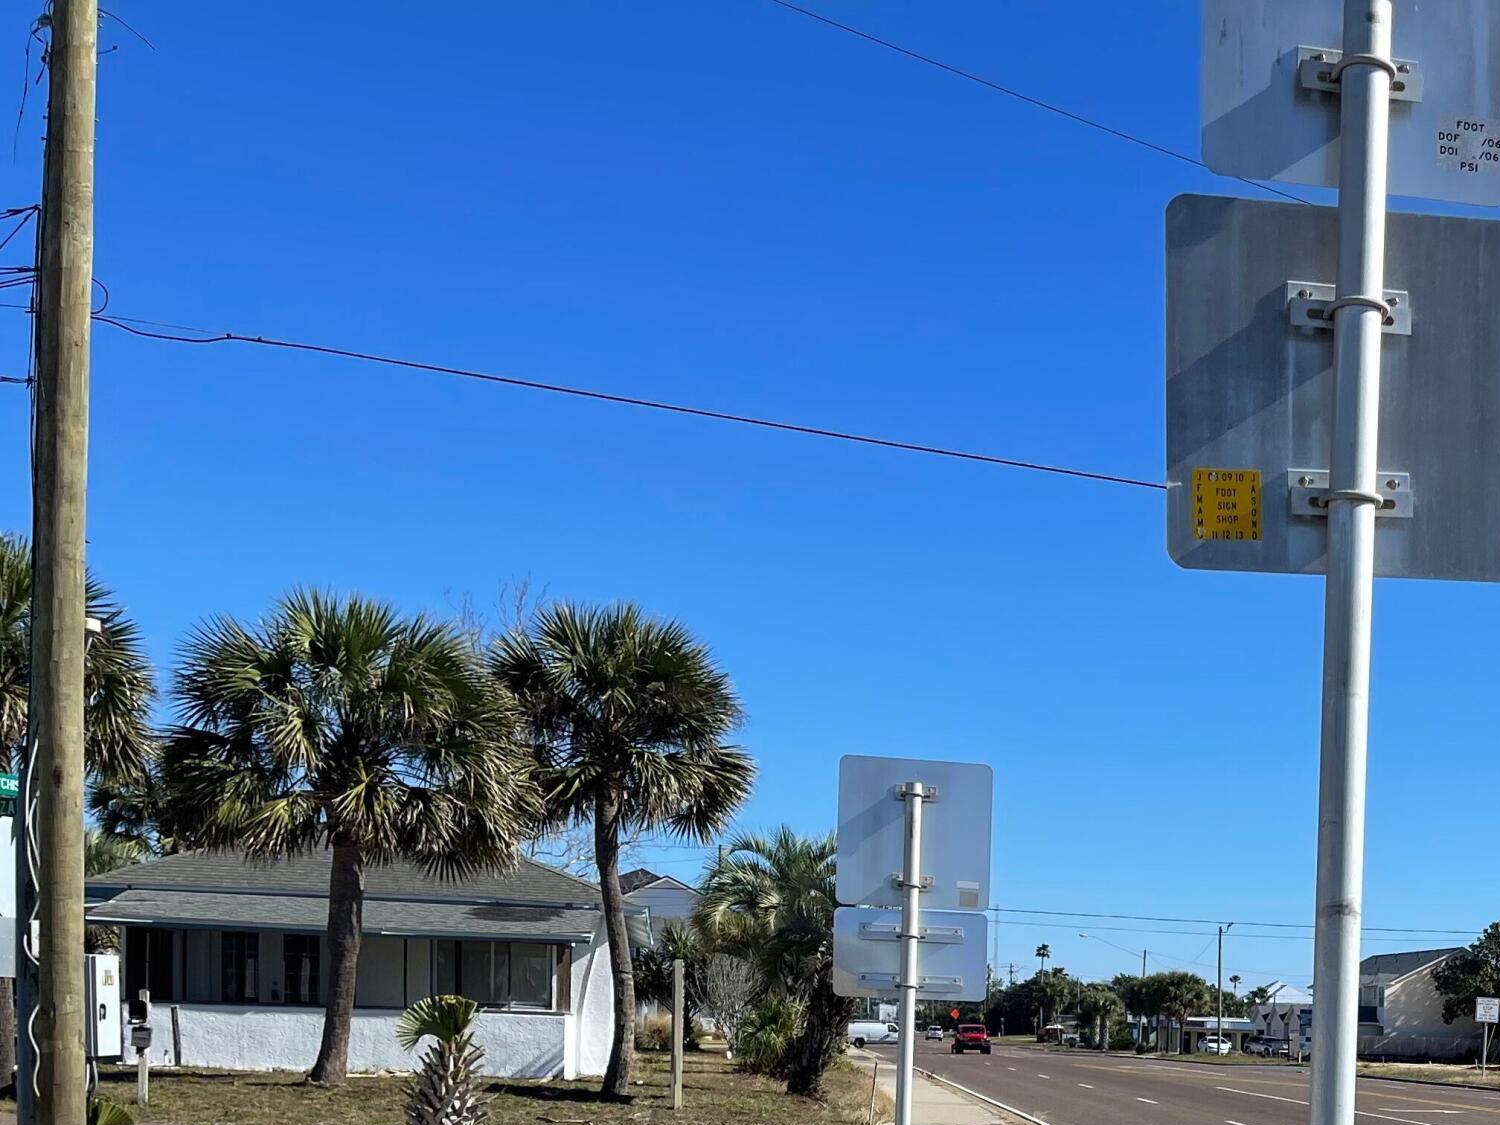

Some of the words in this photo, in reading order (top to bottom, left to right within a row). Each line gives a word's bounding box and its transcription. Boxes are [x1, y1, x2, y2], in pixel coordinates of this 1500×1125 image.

[1456, 120, 1485, 132] FDOT
[1438, 131, 1460, 142] DOF
[1439, 145, 1458, 156] DOI
[1478, 151, 1499, 162] /06
[1460, 161, 1478, 172] PSI
[1221, 472, 1233, 482] 09
[1235, 472, 1244, 482] 10
[1215, 488, 1237, 497] FDOT
[1217, 502, 1237, 511] SIGN
[1216, 515, 1239, 524] SHOP
[1212, 530, 1218, 539] 11
[1222, 530, 1231, 540] 12
[1235, 530, 1244, 540] 13
